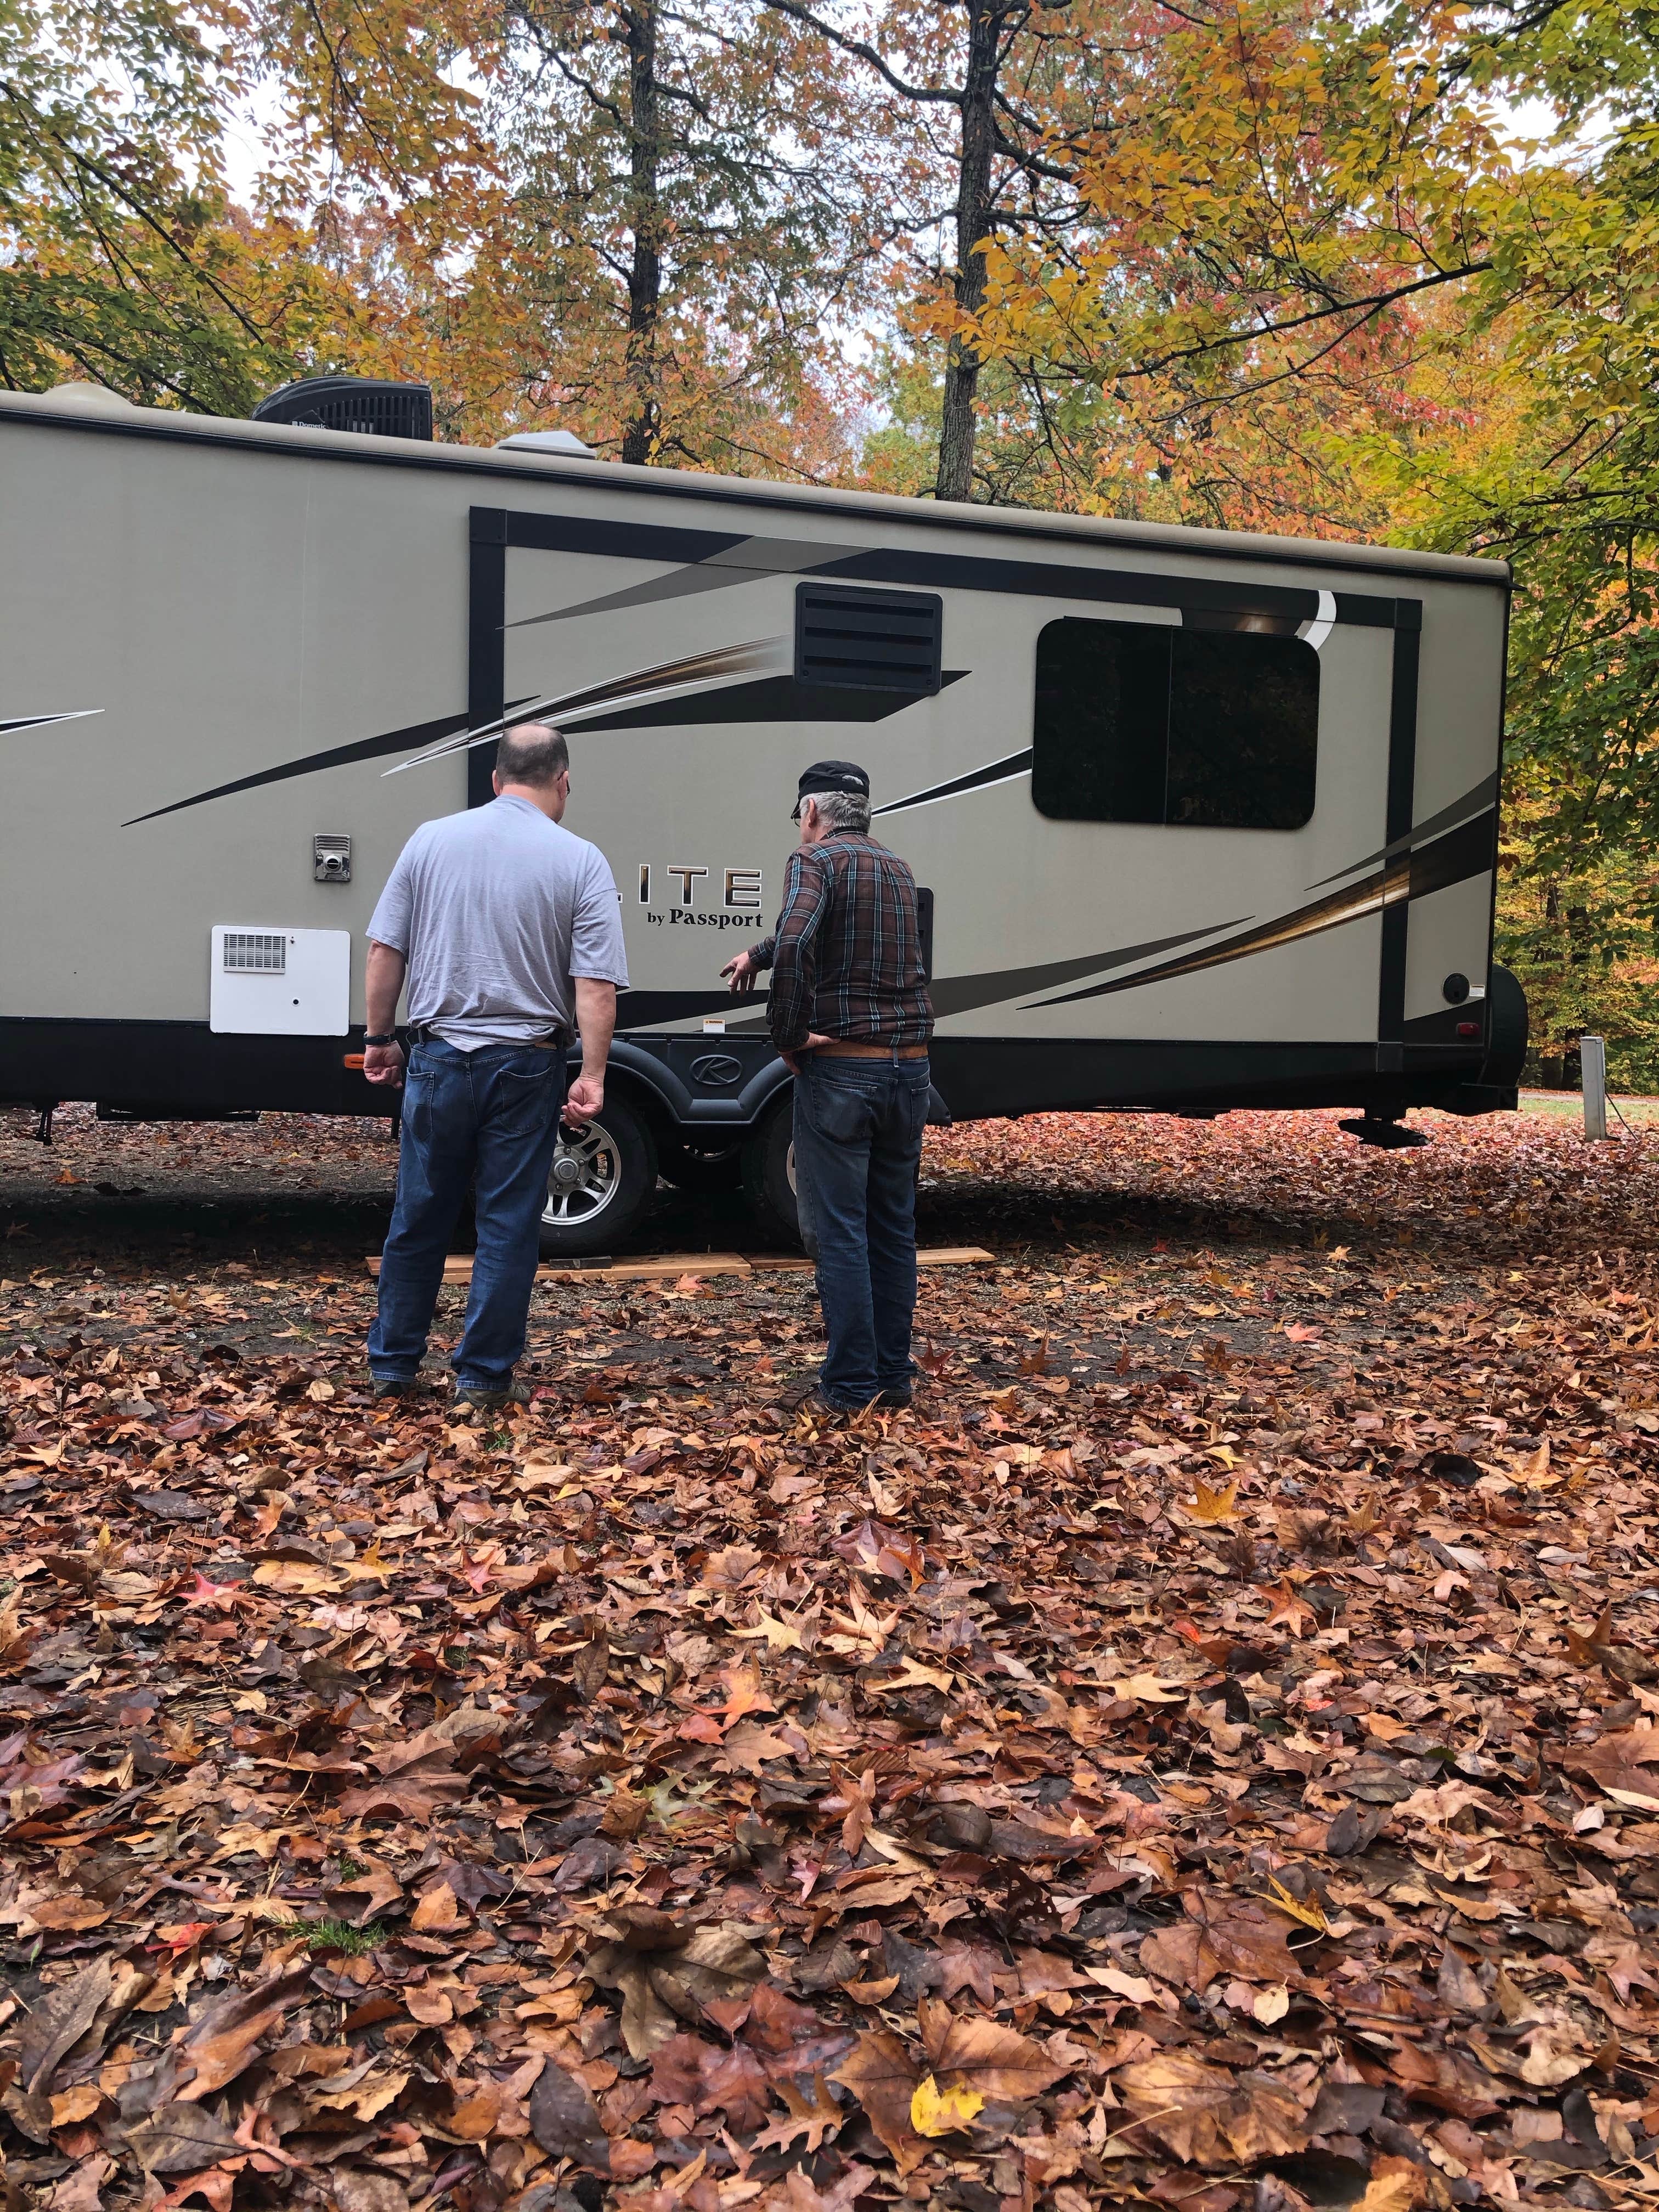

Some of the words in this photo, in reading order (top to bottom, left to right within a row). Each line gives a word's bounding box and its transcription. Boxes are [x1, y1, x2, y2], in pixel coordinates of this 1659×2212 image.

[617, 864, 762, 909] ITE
[647, 912, 665, 926] by
[669, 909, 763, 929] Passport
